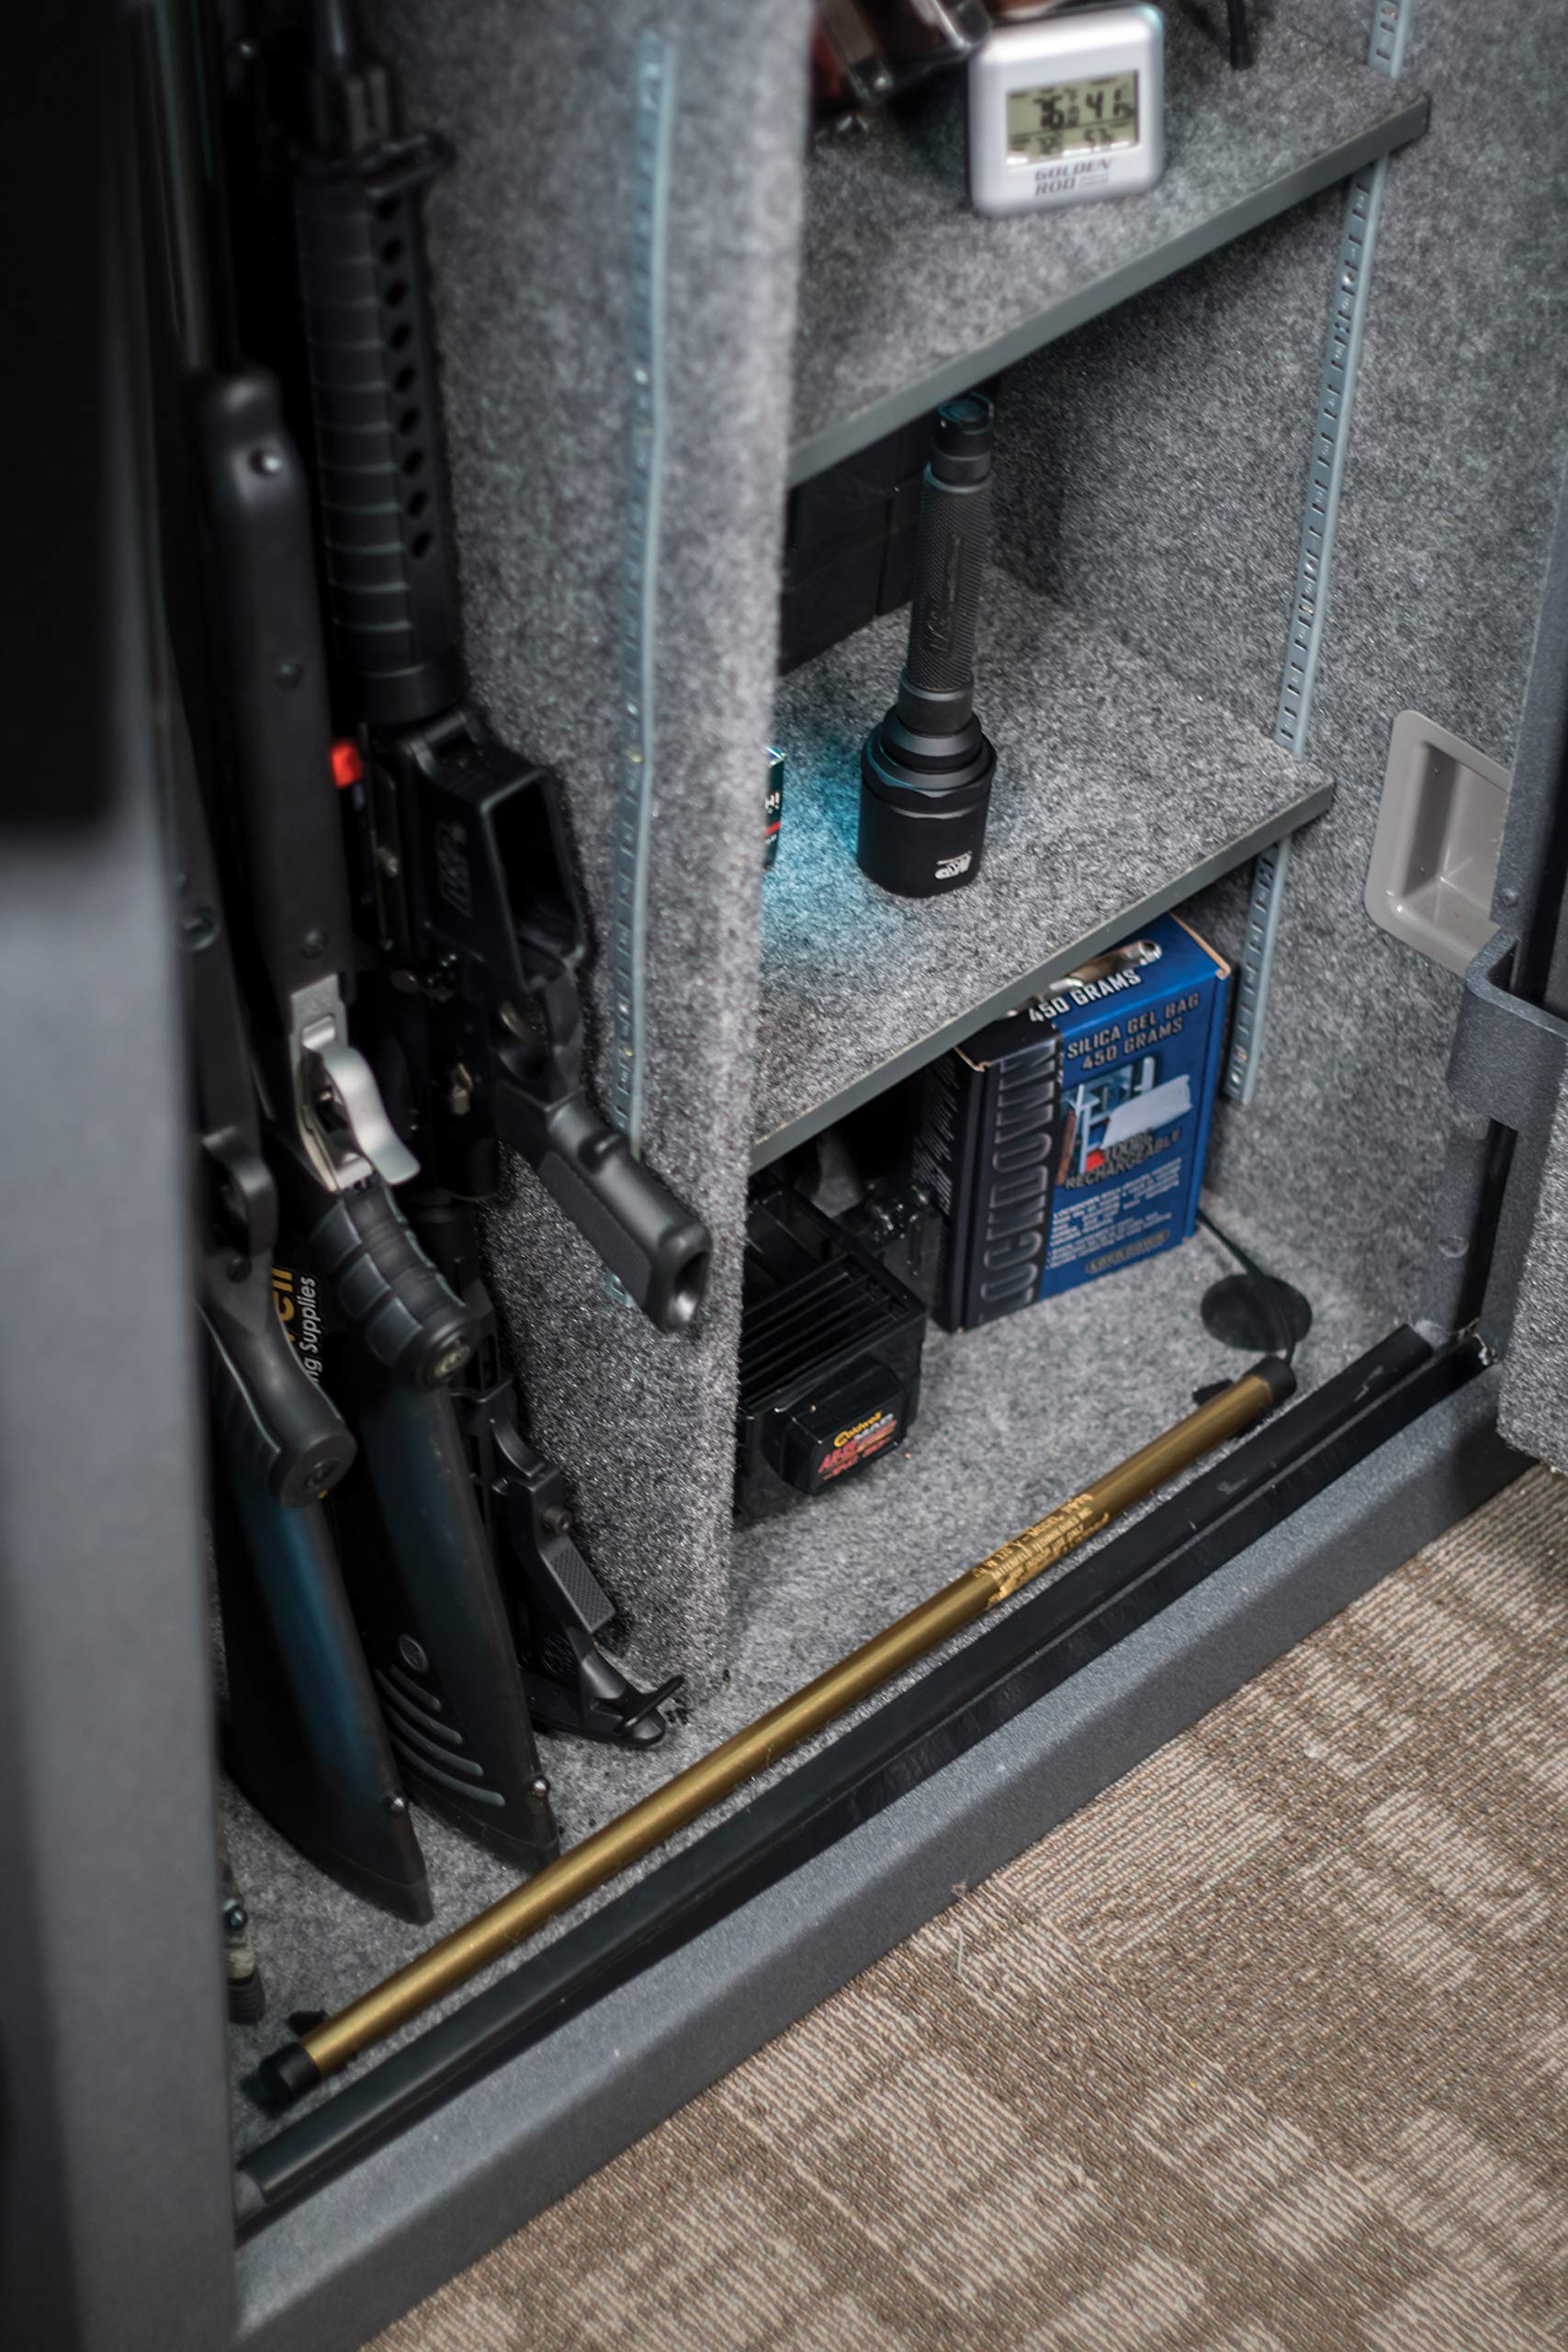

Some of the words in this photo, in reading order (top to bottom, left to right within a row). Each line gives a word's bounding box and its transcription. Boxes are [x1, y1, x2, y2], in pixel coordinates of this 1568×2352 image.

[1035, 159, 1111, 181] GOLDEN
[1035, 177, 1077, 196] ROD
[1029, 997, 1070, 1023] 450
[1071, 968, 1142, 1007] GRAMS
[1066, 1025, 1121, 1059] SILICA
[1128, 1011, 1158, 1035] GEL
[1165, 993, 1200, 1020] BAG
[1081, 1045, 1118, 1070] 450
[1124, 1017, 1184, 1055] GRAMS
[979, 1040, 1056, 1321] LOCKDOWN
[1066, 1128, 1182, 1190] RECHARGEABLE
[298, 1276, 321, 1354] Supplies
